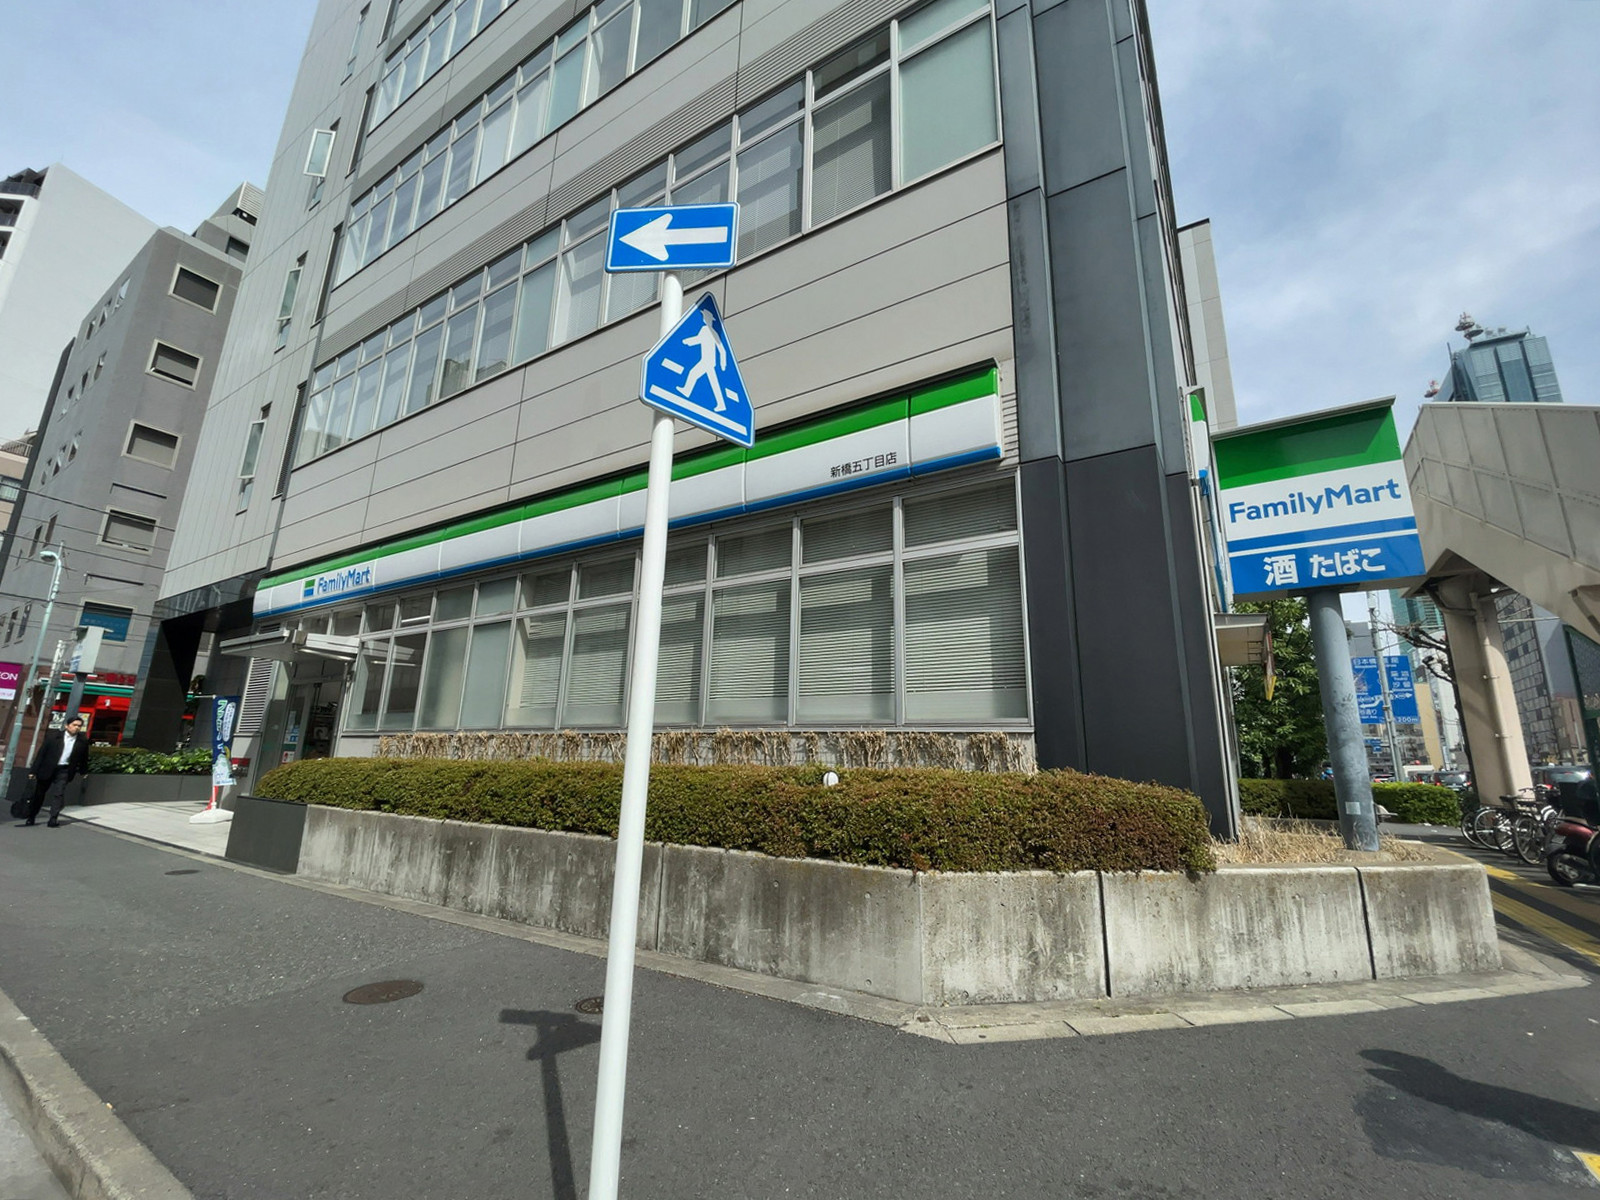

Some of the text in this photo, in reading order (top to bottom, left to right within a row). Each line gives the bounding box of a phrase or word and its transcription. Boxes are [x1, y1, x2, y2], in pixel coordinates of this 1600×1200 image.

[830, 451, 897, 478] 新橋五丁目店
[1228, 478, 1402, 524] FamilyMart
[317, 566, 371, 594] FamilyMart
[1263, 548, 1386, 586] 酒 たばこ
[0, 672, 18, 681] ON
